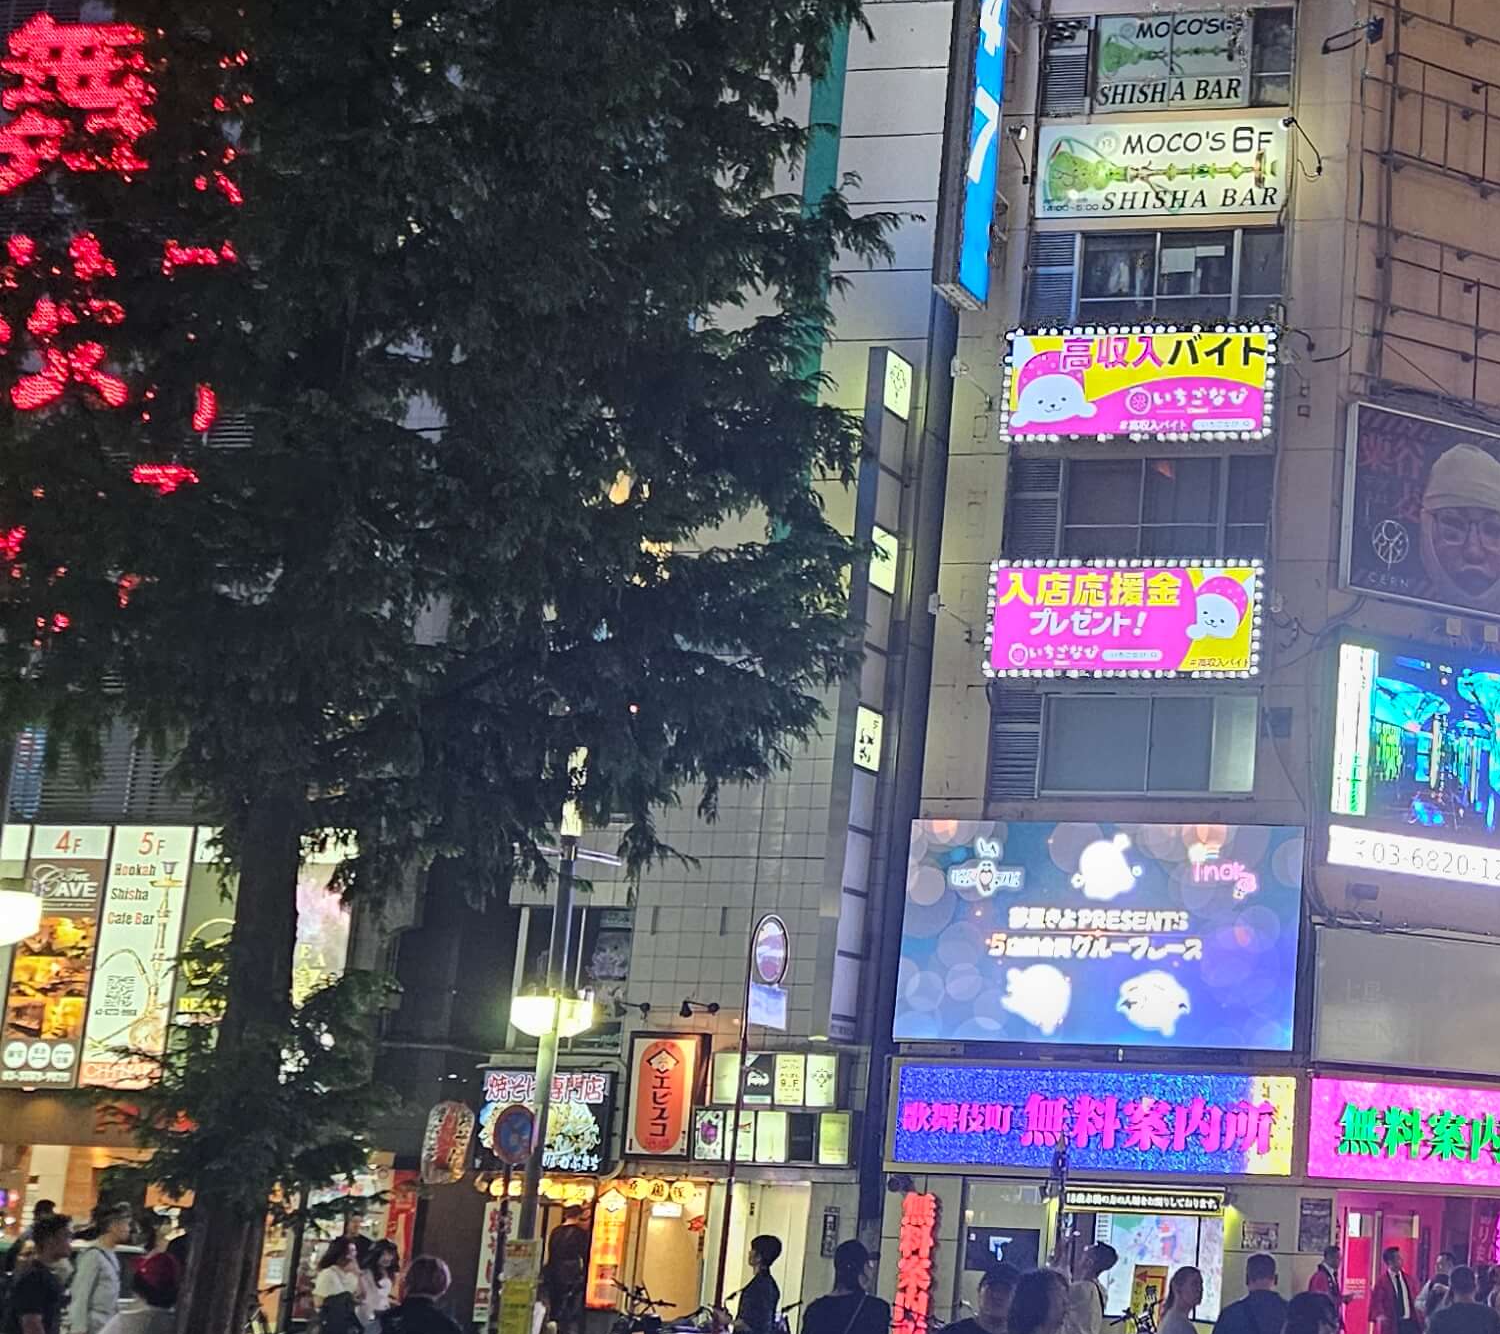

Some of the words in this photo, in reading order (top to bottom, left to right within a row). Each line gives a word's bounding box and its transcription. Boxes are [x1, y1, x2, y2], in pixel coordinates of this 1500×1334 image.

[1134, 17, 1220, 39] MOCO'S
[1095, 80, 1186, 106] SHISHA
[1194, 78, 1242, 100] BAR
[1122, 130, 1226, 155] MOCO'S
[1232, 125, 1274, 154] 6F
[1101, 188, 1207, 211] SHISHA
[1220, 187, 1278, 208] BAR
[1060, 335, 1266, 372] 高収入バイト
[1152, 388, 1248, 407] いちごなび
[998, 572, 1183, 607] 入店応援金
[1028, 645, 1100, 660] いちごなび
[55, 831, 83, 854] 4F
[138, 831, 166, 855] 5F
[114, 862, 157, 877] Hookah
[110, 887, 150, 901] Shisha
[107, 912, 133, 925] Cafe
[134, 912, 155, 926] Bar
[485, 1072, 606, 1105] 焼そ専門店
[649, 1074, 671, 1137] エビスコ
[901, 1100, 1013, 1135] 歌舞伎町
[1020, 1093, 1280, 1156] 無料案内所
